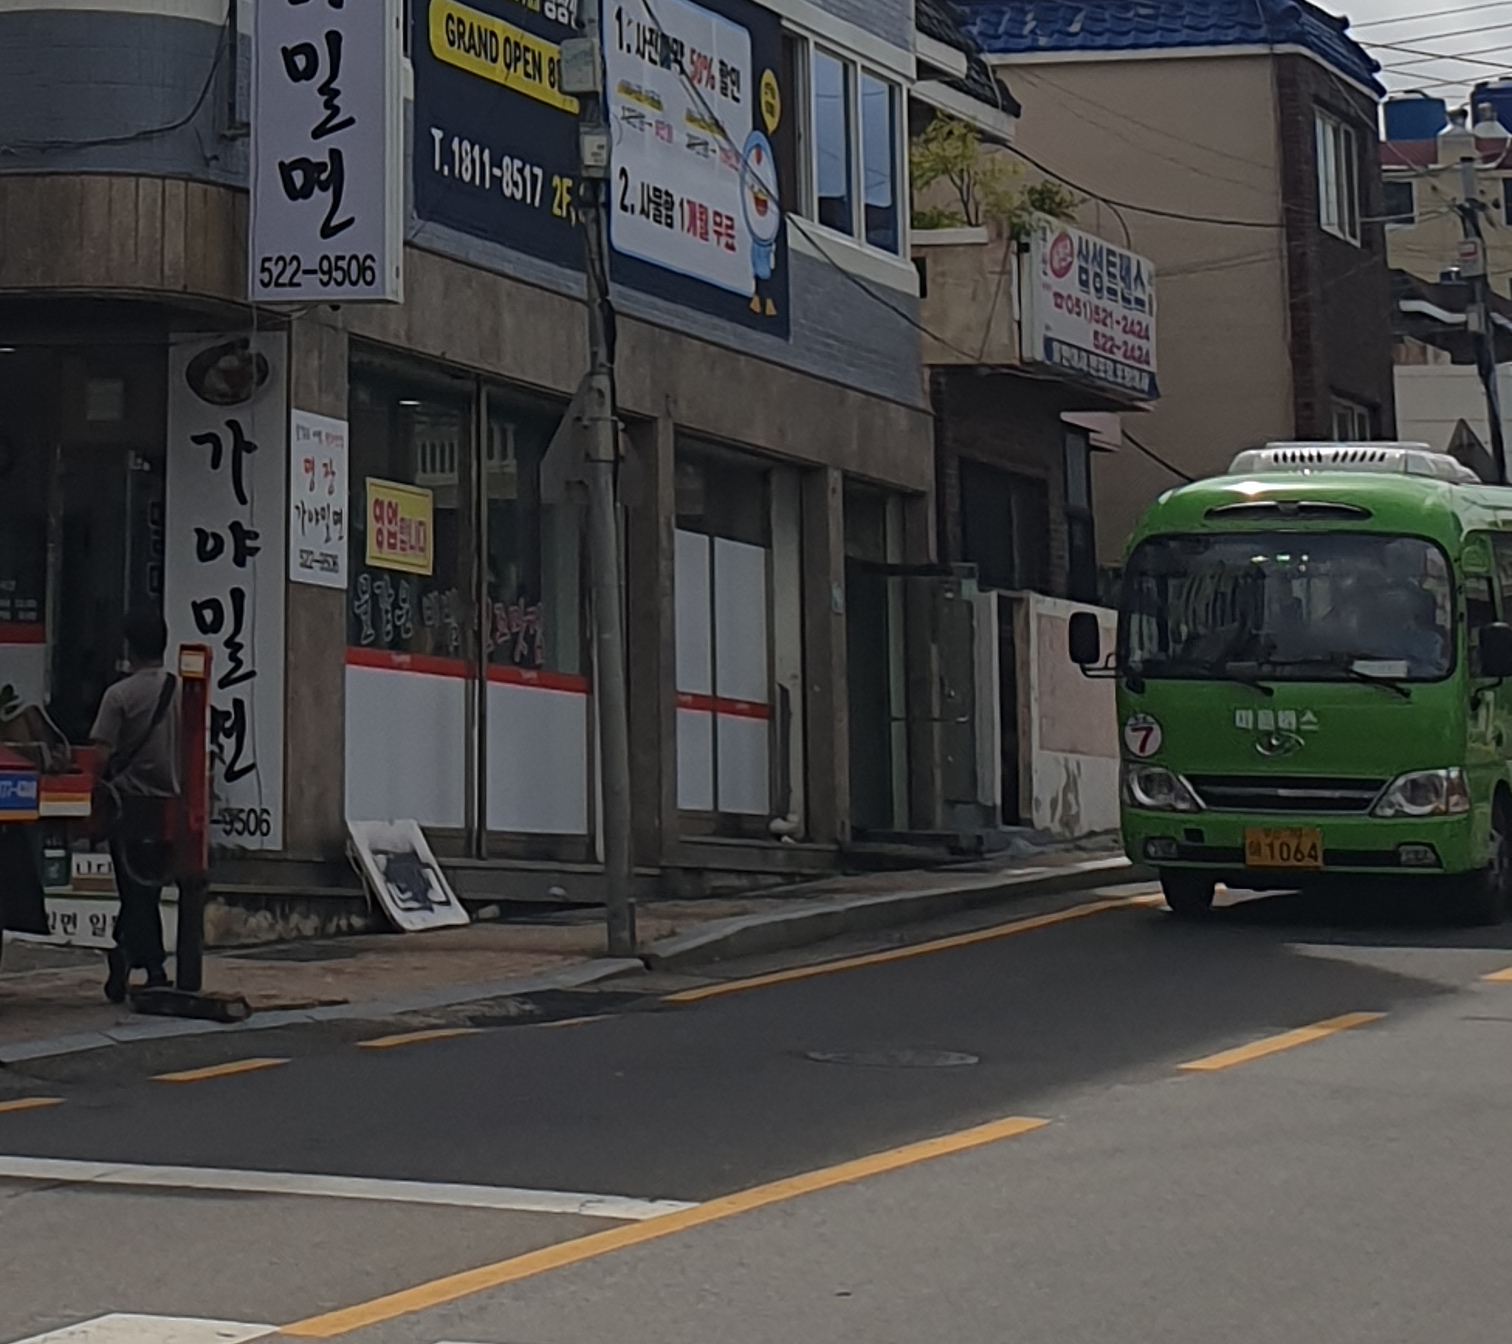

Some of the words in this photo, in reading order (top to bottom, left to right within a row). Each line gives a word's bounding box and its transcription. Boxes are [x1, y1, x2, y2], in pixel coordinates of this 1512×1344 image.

[445, 13, 499, 64] GRAND
[503, 36, 542, 84] OPEN
[548, 56, 560, 89] 8
[615, 5, 631, 54] 1.
[634, 21, 685, 76] 사전약
[689, 47, 716, 91] 50%
[718, 58, 741, 104] 할인
[430, 127, 543, 208] T.1811-8517
[619, 166, 635, 215] 2.
[639, 181, 675, 230] 사물함
[712, 210, 737, 252] 무료
[259, 253, 376, 288] 522-9506
[294, 499, 344, 544] 가야밀면
[190, 418, 262, 783] 가야밀면
[1131, 725, 1155, 754] 7
[209, 808, 272, 838] -9506
[1263, 839, 1319, 863] 1064
